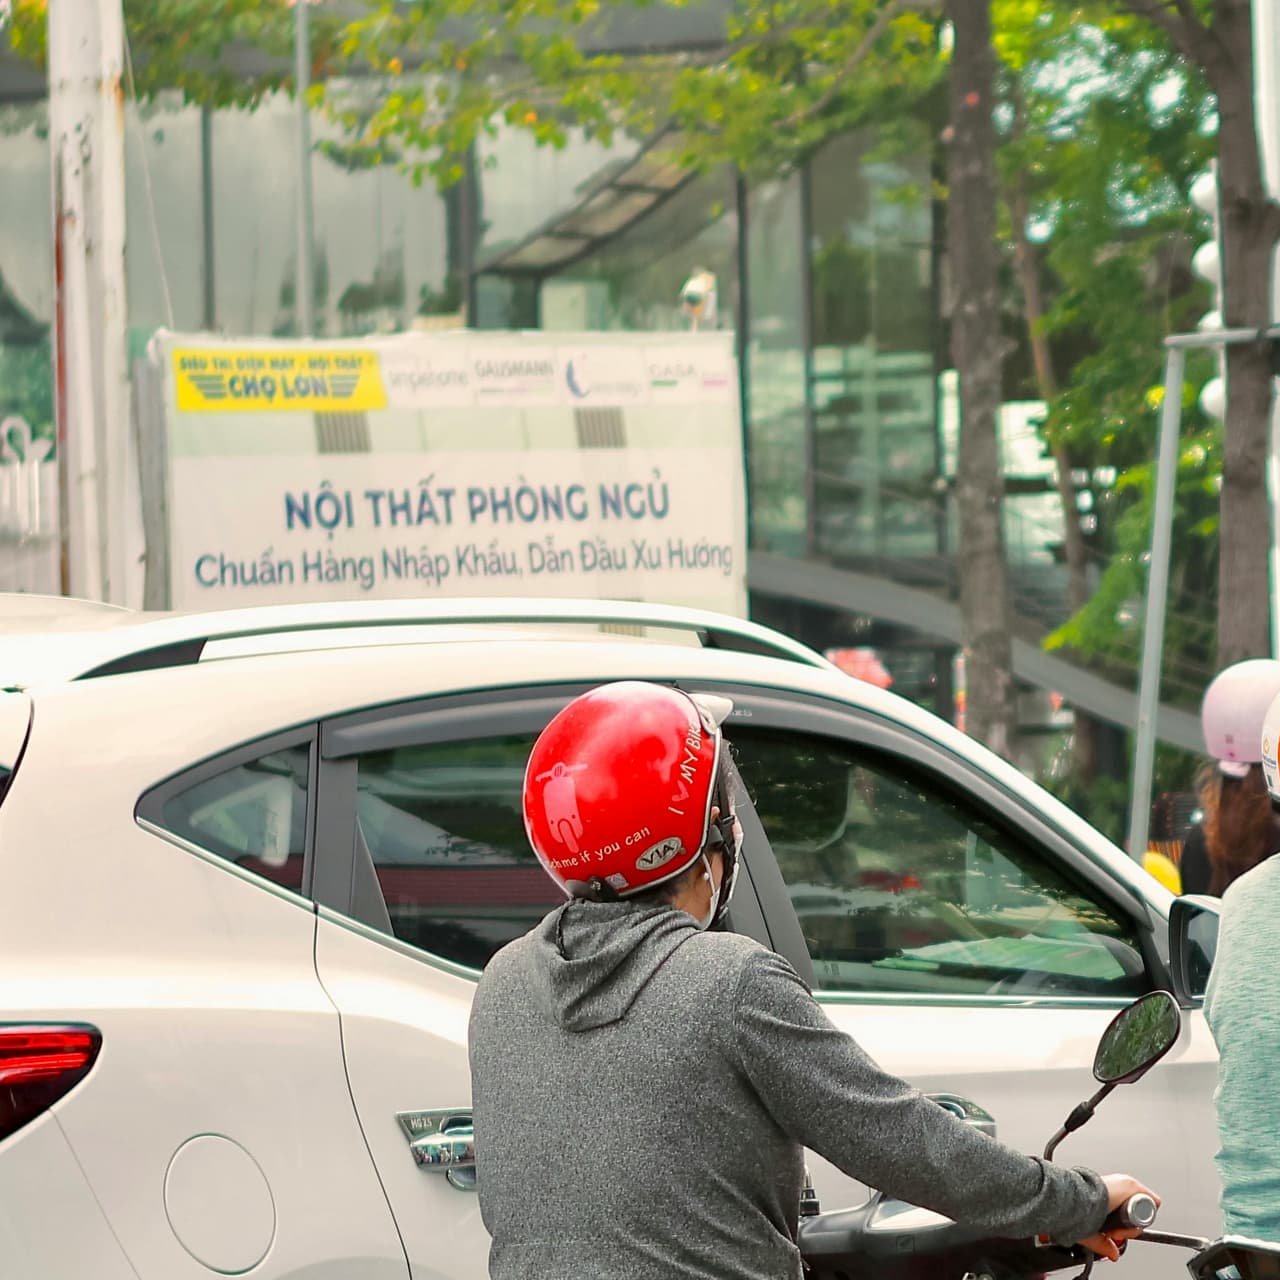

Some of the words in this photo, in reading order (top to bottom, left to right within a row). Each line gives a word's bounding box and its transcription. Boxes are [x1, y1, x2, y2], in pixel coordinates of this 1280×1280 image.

[284, 480, 354, 540] NỘI
[364, 473, 455, 527] THẤT
[467, 473, 589, 523] PHÒNG
[600, 467, 669, 519] NGỦ
[302, 548, 375, 590] Hàng
[382, 546, 450, 588] Nhập
[632, 538, 662, 570] Xu
[668, 536, 733, 577] Hướng
[680, 747, 698, 784] MY
[579, 850, 591, 863] if
[595, 842, 621, 860] you
[625, 827, 651, 845] can
[641, 844, 675, 865] VIA
